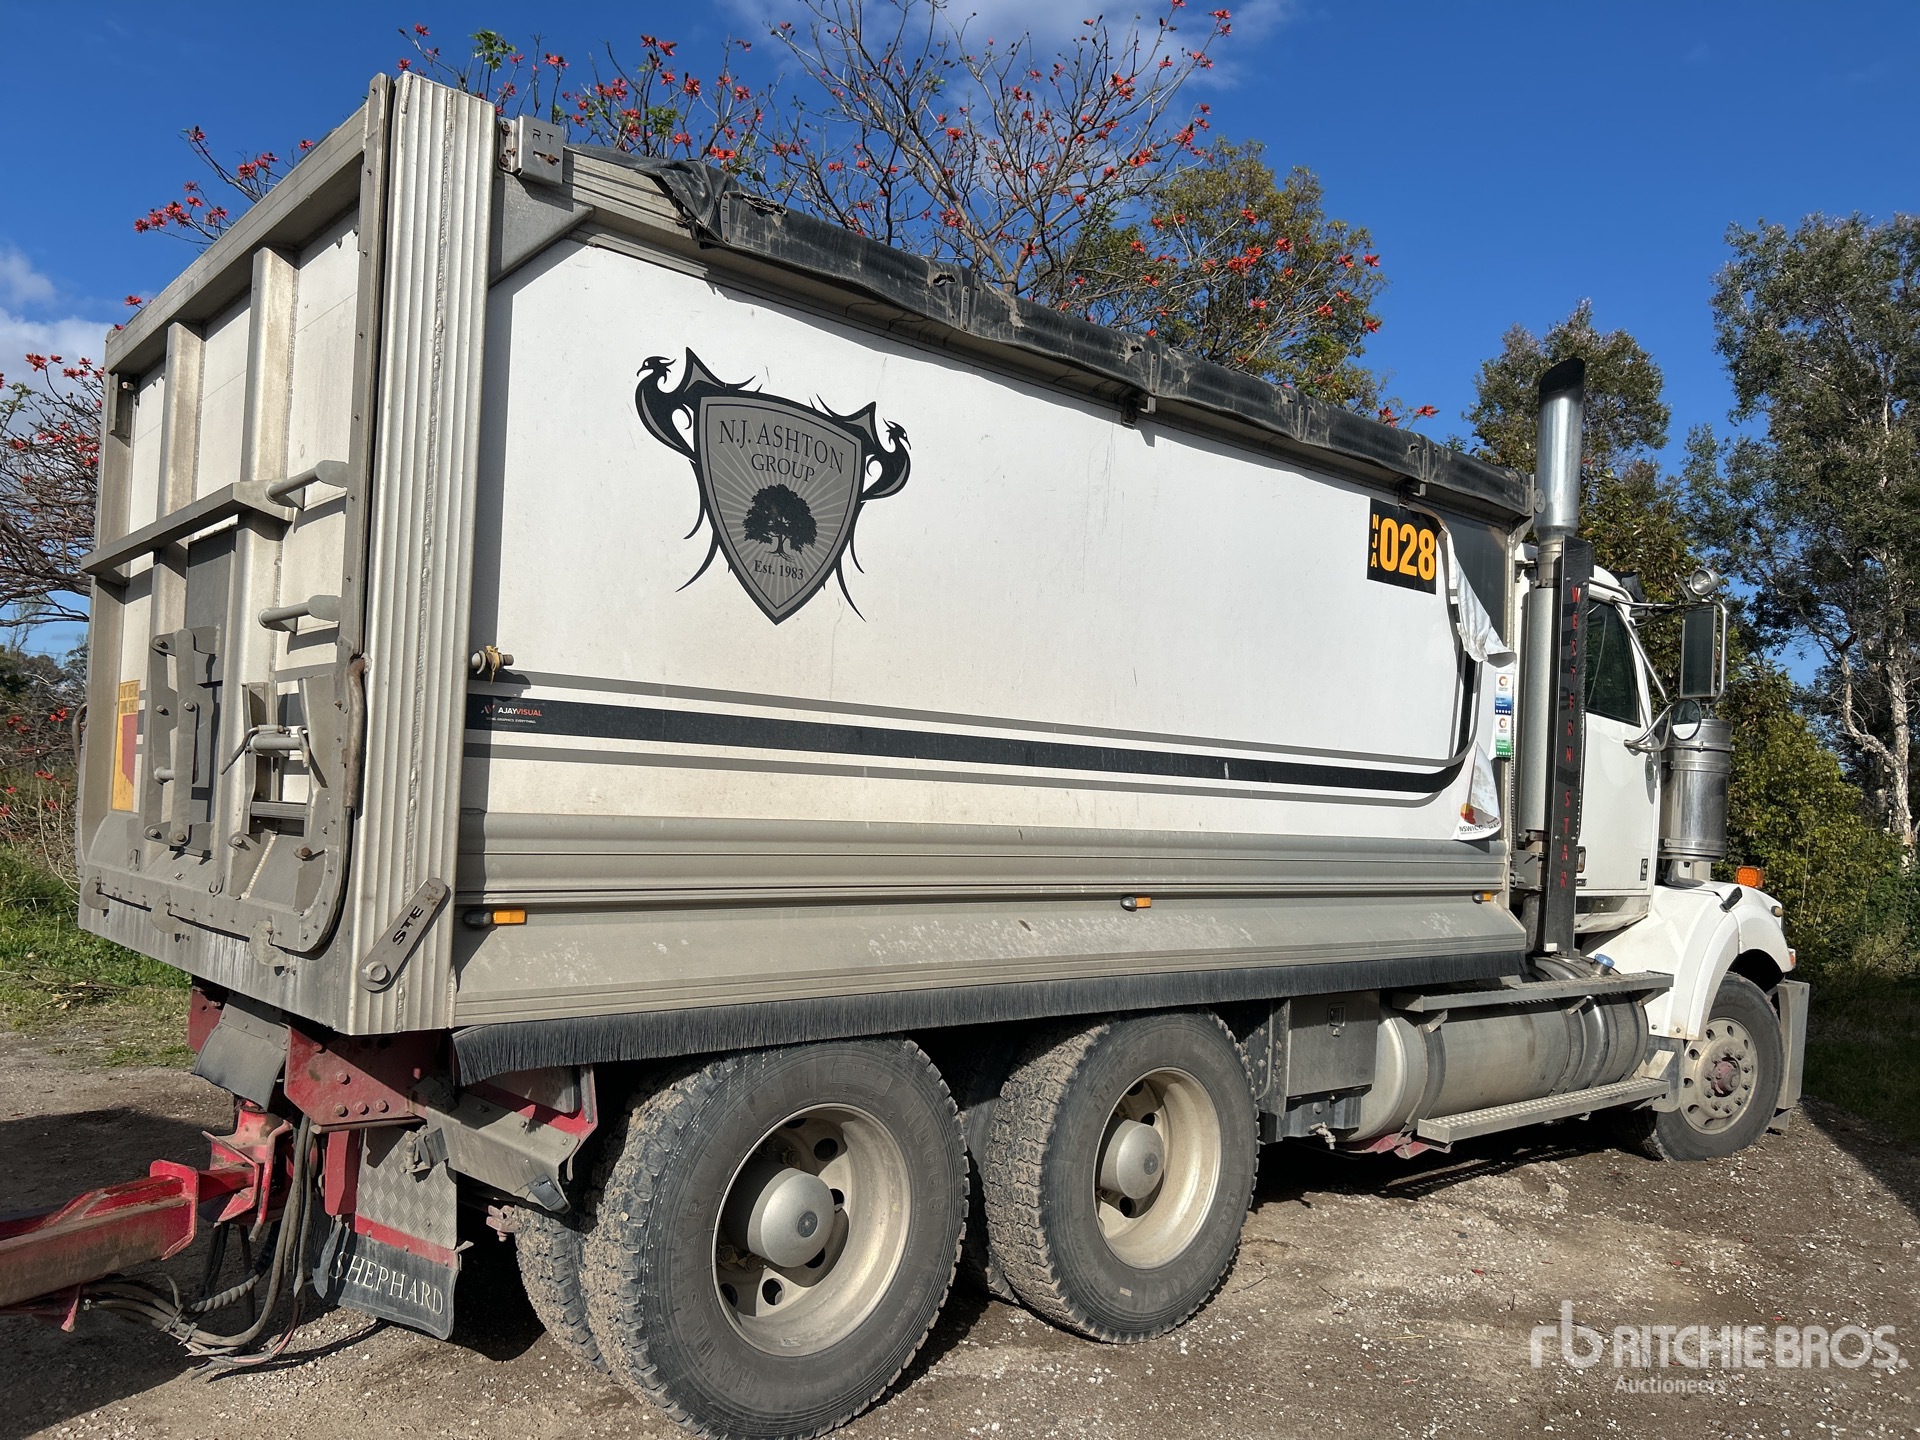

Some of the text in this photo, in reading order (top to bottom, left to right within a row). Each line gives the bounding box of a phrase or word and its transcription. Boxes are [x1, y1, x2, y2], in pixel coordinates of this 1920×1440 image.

[718, 419, 844, 475] N.J. ASHTON
[751, 453, 815, 483] GROUP
[1370, 513, 1380, 568] NJA
[1380, 517, 1436, 581] 028
[753, 559, 804, 581] Est. 1983
[498, 706, 542, 716] AJAYVISUAL
[1559, 586, 1582, 888] WESTERN STAR
[392, 905, 425, 945] STE
[328, 1250, 444, 1316] SHEPHARD
[672, 1199, 757, 1395] HAULSTAR
